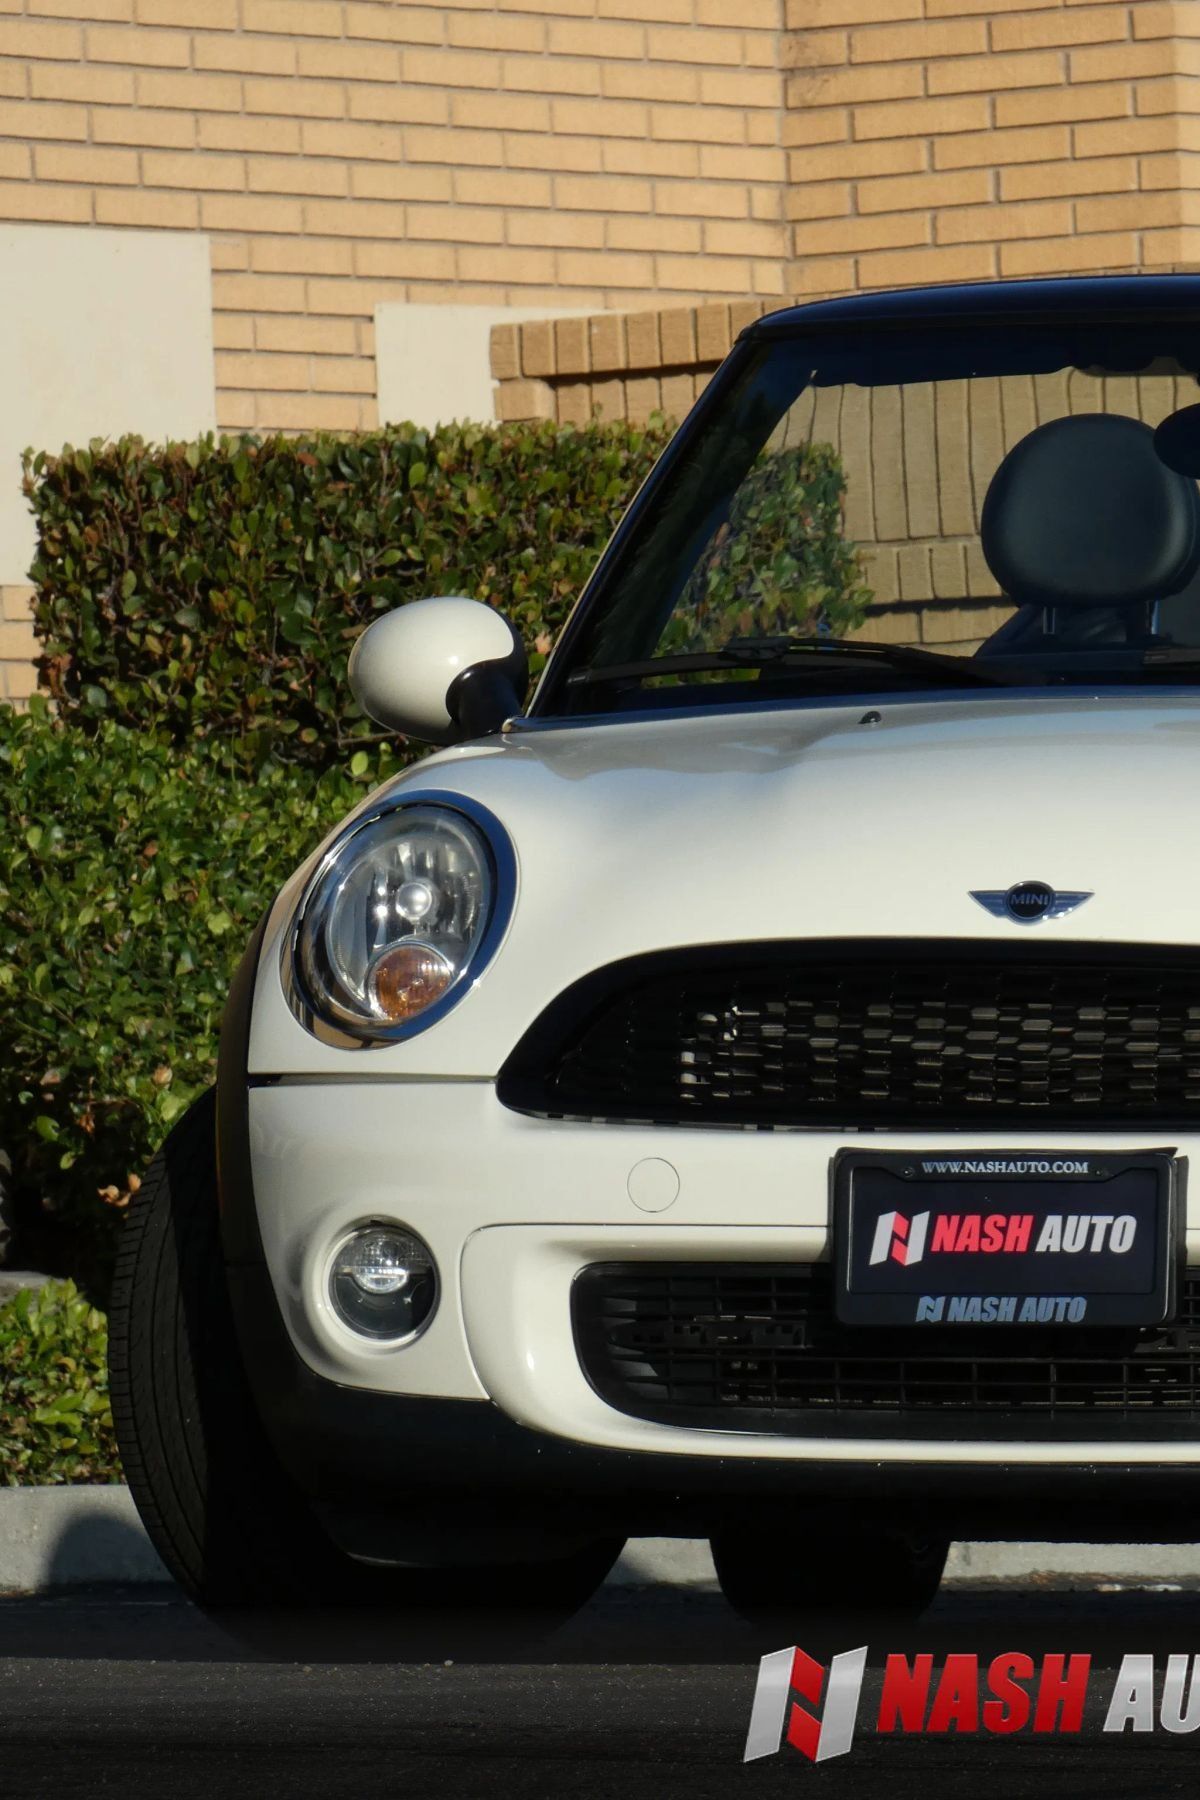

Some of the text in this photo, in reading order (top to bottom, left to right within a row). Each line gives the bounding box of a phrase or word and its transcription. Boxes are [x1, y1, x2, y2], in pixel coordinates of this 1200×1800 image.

[1010, 893, 1049, 906] MINI
[921, 1160, 1089, 1174] WWW.NASHAUTO.COM
[931, 1214, 1035, 1253] NASH
[1035, 1214, 1138, 1254] AUTO
[946, 1296, 1018, 1322] NASH
[1017, 1296, 1088, 1323] AUTO
